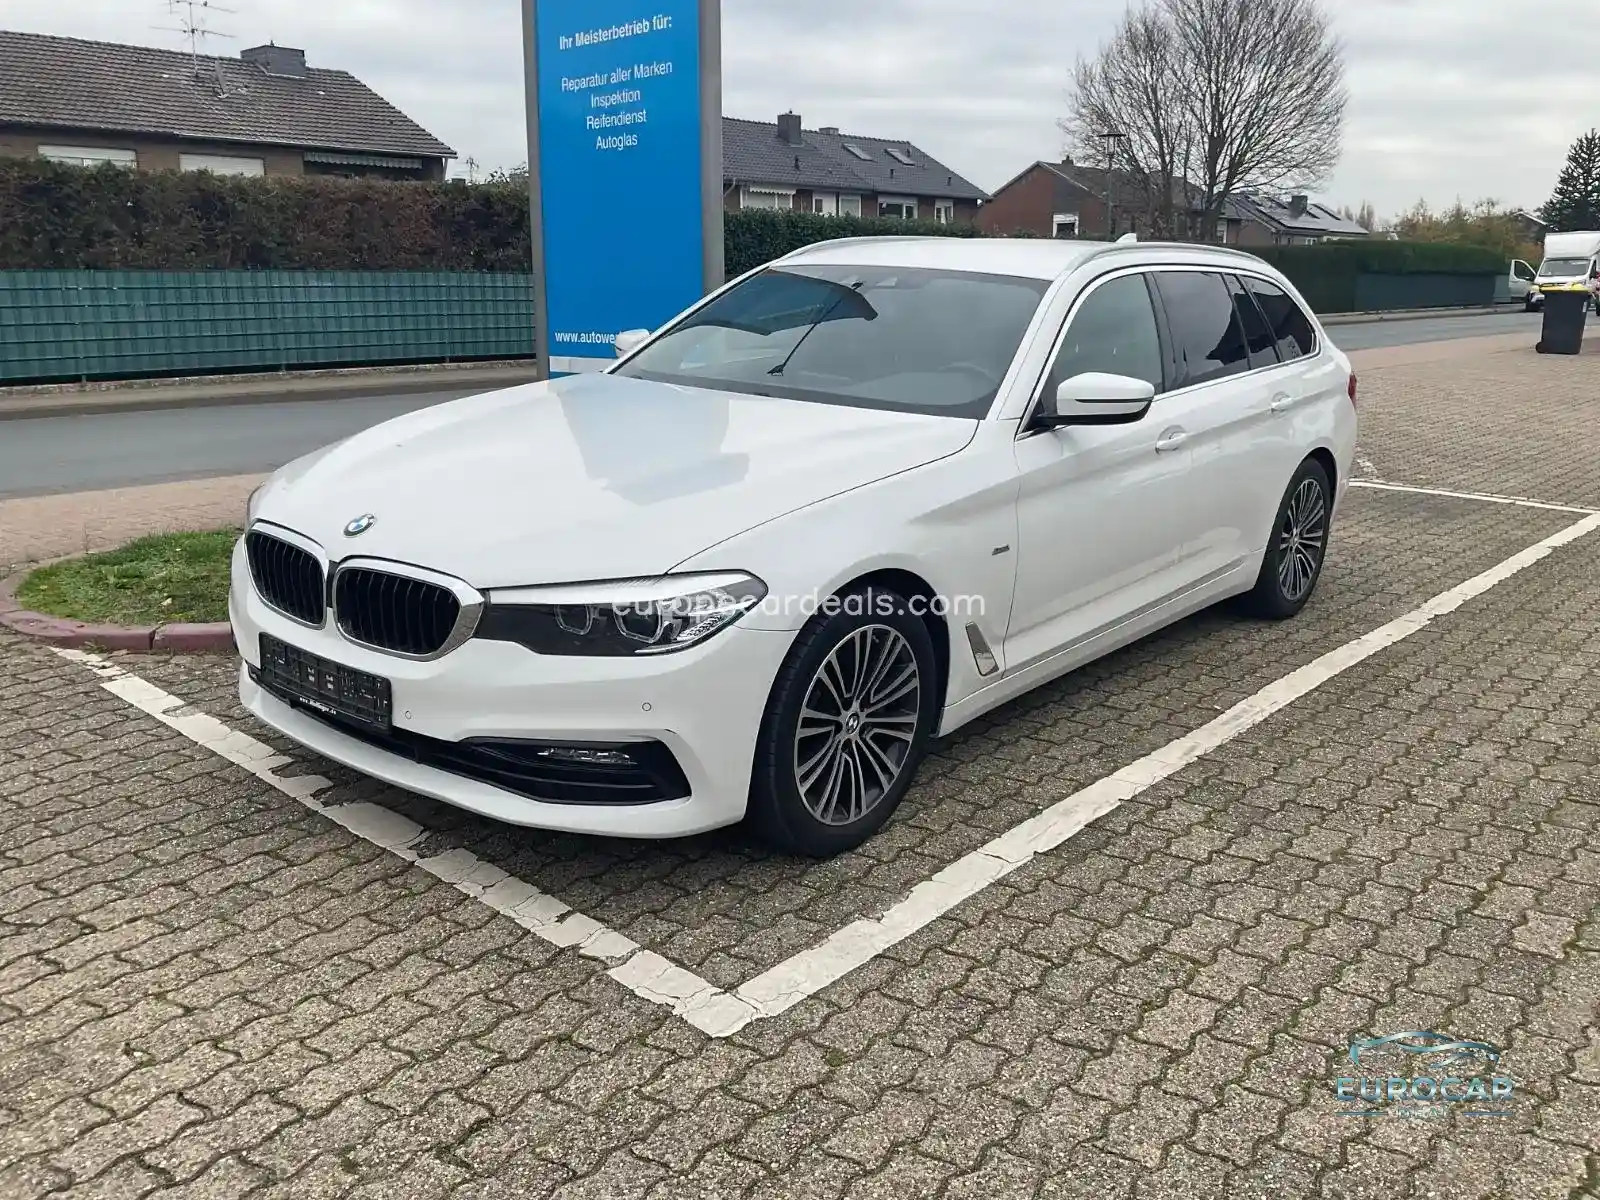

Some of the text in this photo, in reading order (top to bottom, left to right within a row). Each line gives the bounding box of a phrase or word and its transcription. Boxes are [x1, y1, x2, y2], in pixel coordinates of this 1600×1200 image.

[559, 14, 673, 50] Ihr Meisterbetrieb für:
[561, 60, 673, 93] Reparatur aller Marken
[590, 88, 641, 109] Inspektion
[586, 108, 647, 130] Reifendienst
[596, 132, 638, 151] Autoglas
[555, 331, 617, 344] www.autowe
